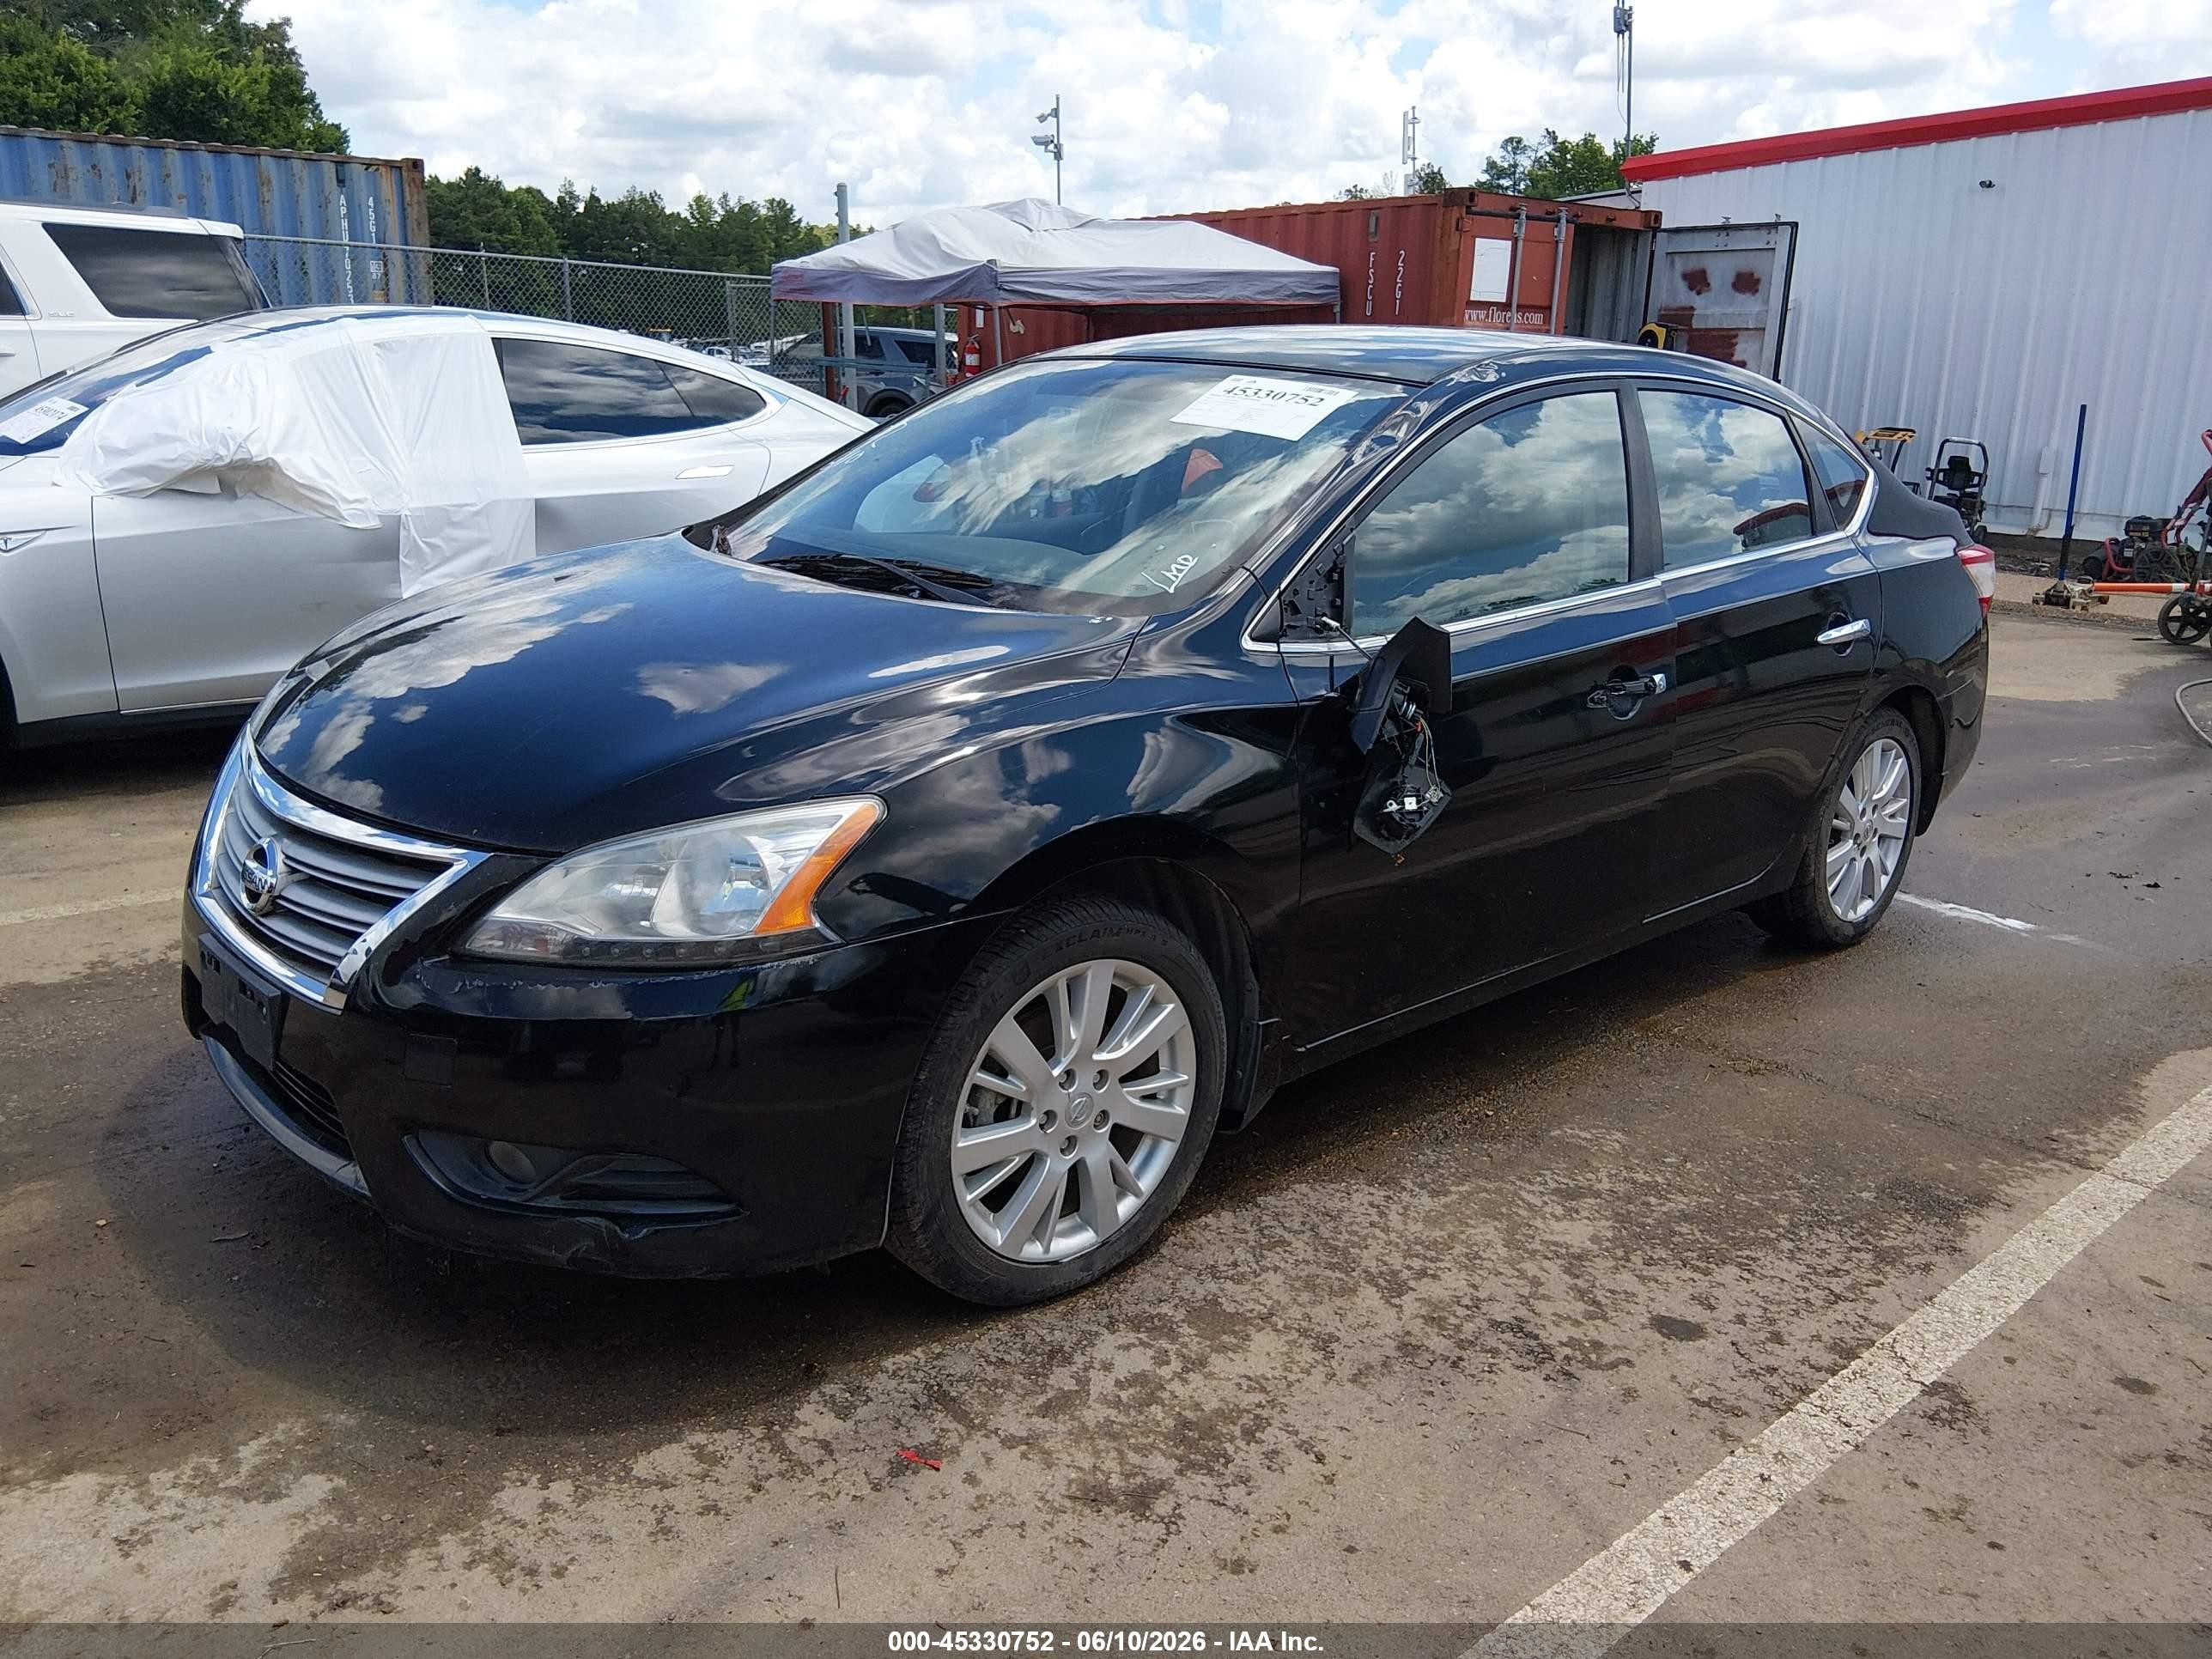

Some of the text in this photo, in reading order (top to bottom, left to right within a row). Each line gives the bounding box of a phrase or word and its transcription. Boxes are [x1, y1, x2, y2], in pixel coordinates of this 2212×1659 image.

[339, 194, 349, 242] APHU
[368, 196, 377, 244] 45G1
[1365, 252, 1376, 316] FSCU
[1395, 250, 1407, 315] 22G1
[1223, 386, 1325, 407] 45330752
